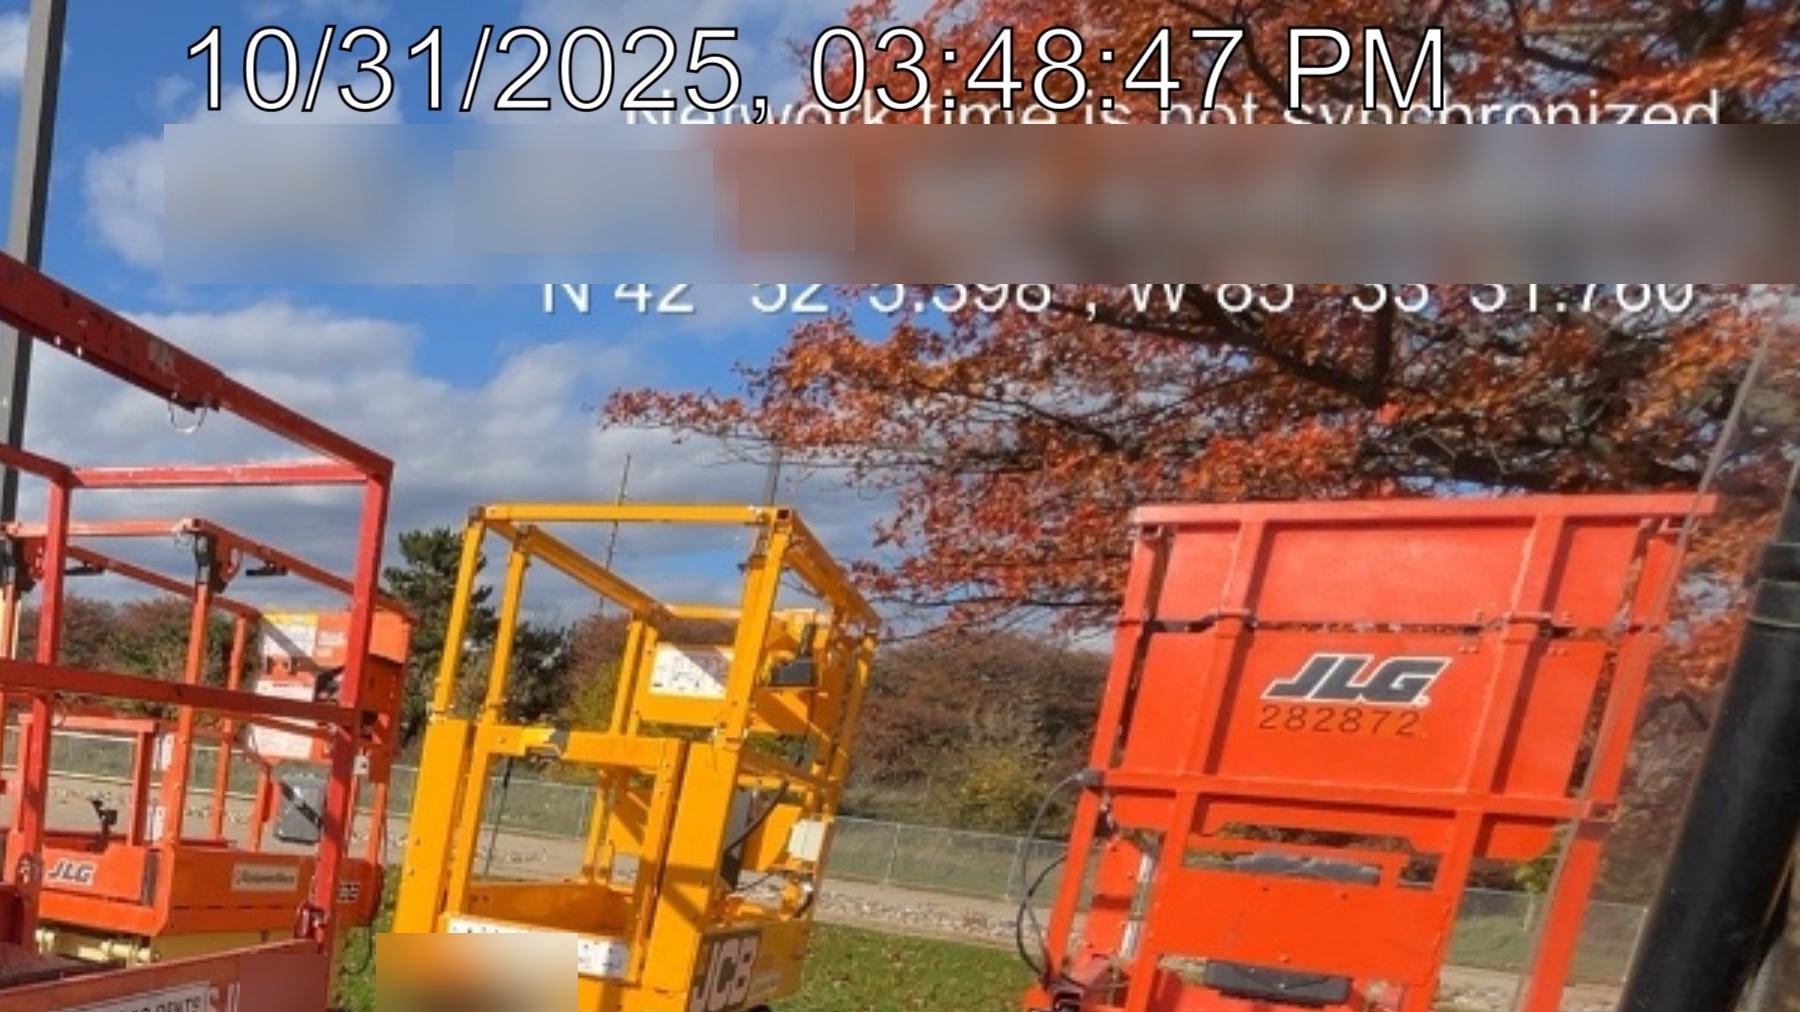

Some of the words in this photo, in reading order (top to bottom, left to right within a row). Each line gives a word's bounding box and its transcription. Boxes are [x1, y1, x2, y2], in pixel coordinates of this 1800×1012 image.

[1260, 653, 1453, 709] JLG
[1259, 704, 1421, 737] 282872
[48, 857, 97, 886] JLG
